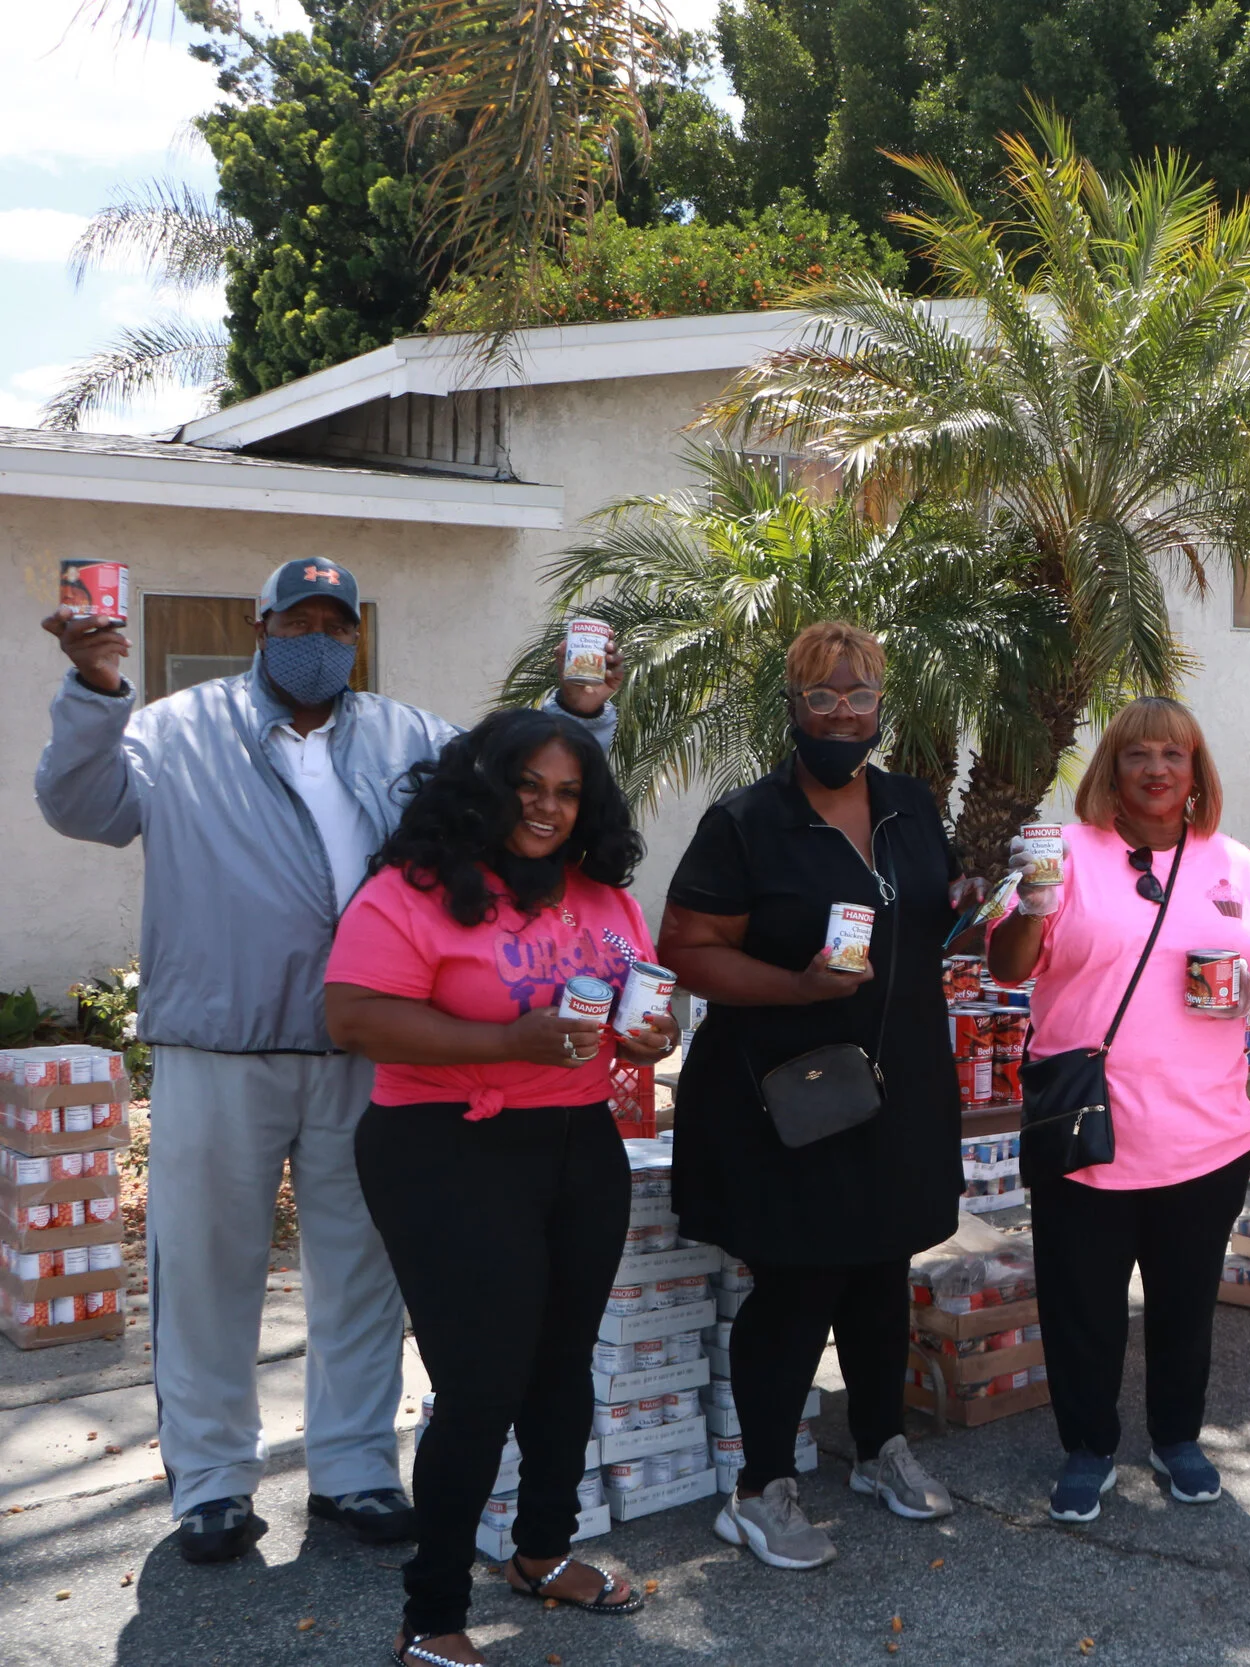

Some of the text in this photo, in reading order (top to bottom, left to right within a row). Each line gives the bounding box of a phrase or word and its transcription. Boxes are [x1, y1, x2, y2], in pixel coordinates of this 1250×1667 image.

[1025, 828, 1061, 837] HANOVER
[846, 910, 875, 923] HANOVE
[1013, 1045, 1024, 1053] Ste
